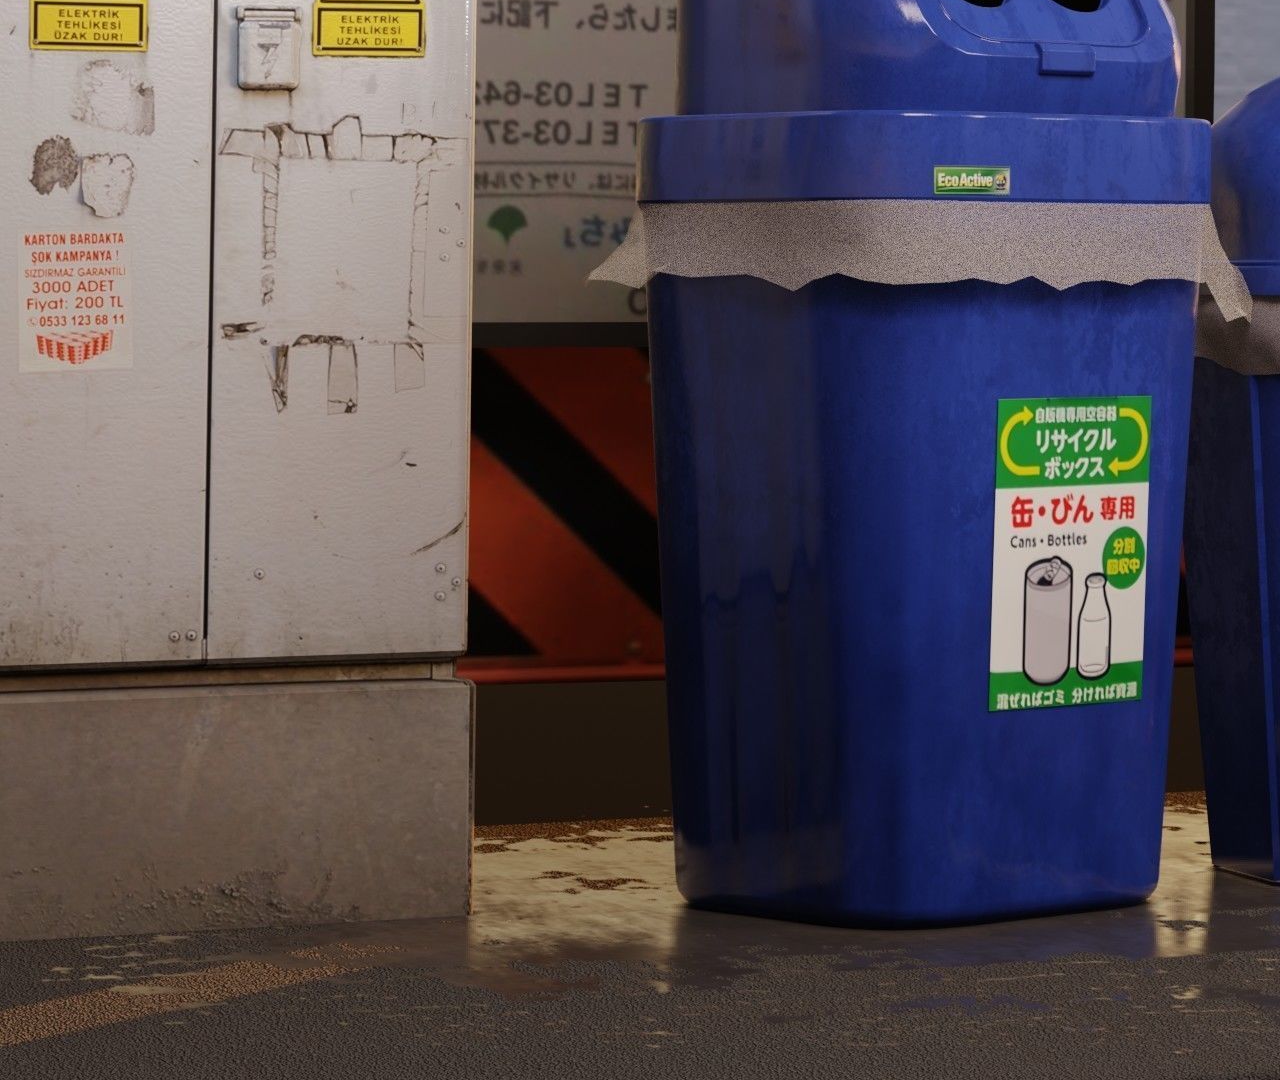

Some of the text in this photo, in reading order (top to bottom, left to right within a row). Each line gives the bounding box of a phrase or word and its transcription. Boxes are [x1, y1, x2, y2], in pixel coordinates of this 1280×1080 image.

[53, 30, 124, 42] UZAK DUR!
[24, 232, 125, 246] KARTON BARDAKTA
[55, 250, 112, 262] KAMPANYA
[32, 280, 115, 294] 3000 ADET
[26, 295, 124, 312] Fiyat: 200 TL
[39, 314, 125, 328] 0533 123 68 11
[1035, 428, 1116, 453] リサイクル
[1044, 456, 1105, 481] ボックス
[1010, 495, 1136, 529] 缶・びん 専用
[996, 681, 1138, 711] 混ぜればゴミ 分ければ資源
